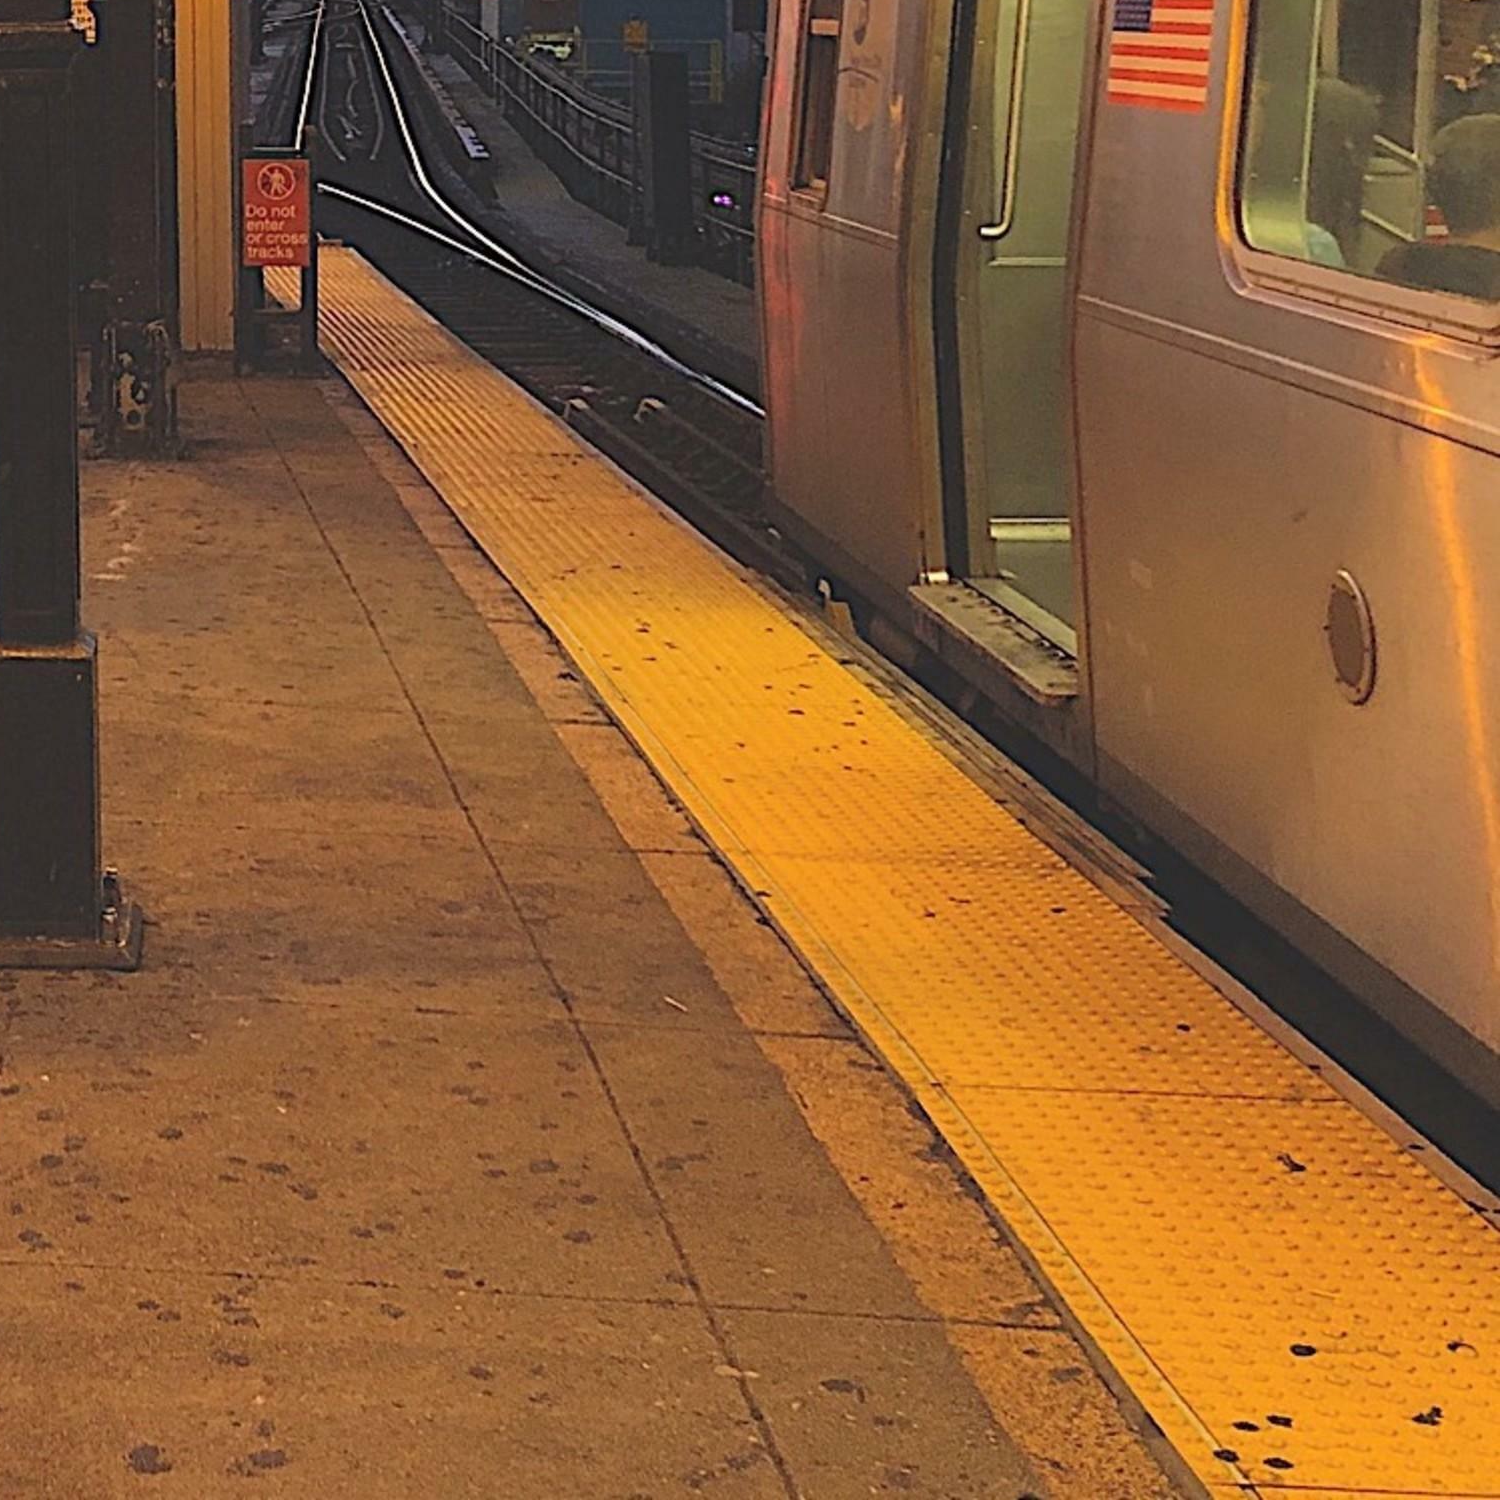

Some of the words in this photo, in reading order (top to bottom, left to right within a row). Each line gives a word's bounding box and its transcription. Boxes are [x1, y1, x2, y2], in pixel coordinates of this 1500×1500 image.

[245, 204, 268, 219] Do
[270, 205, 296, 218] not
[246, 219, 286, 232] enter
[246, 233, 263, 245] or
[265, 233, 308, 245] cross
[246, 245, 295, 259] tracks
